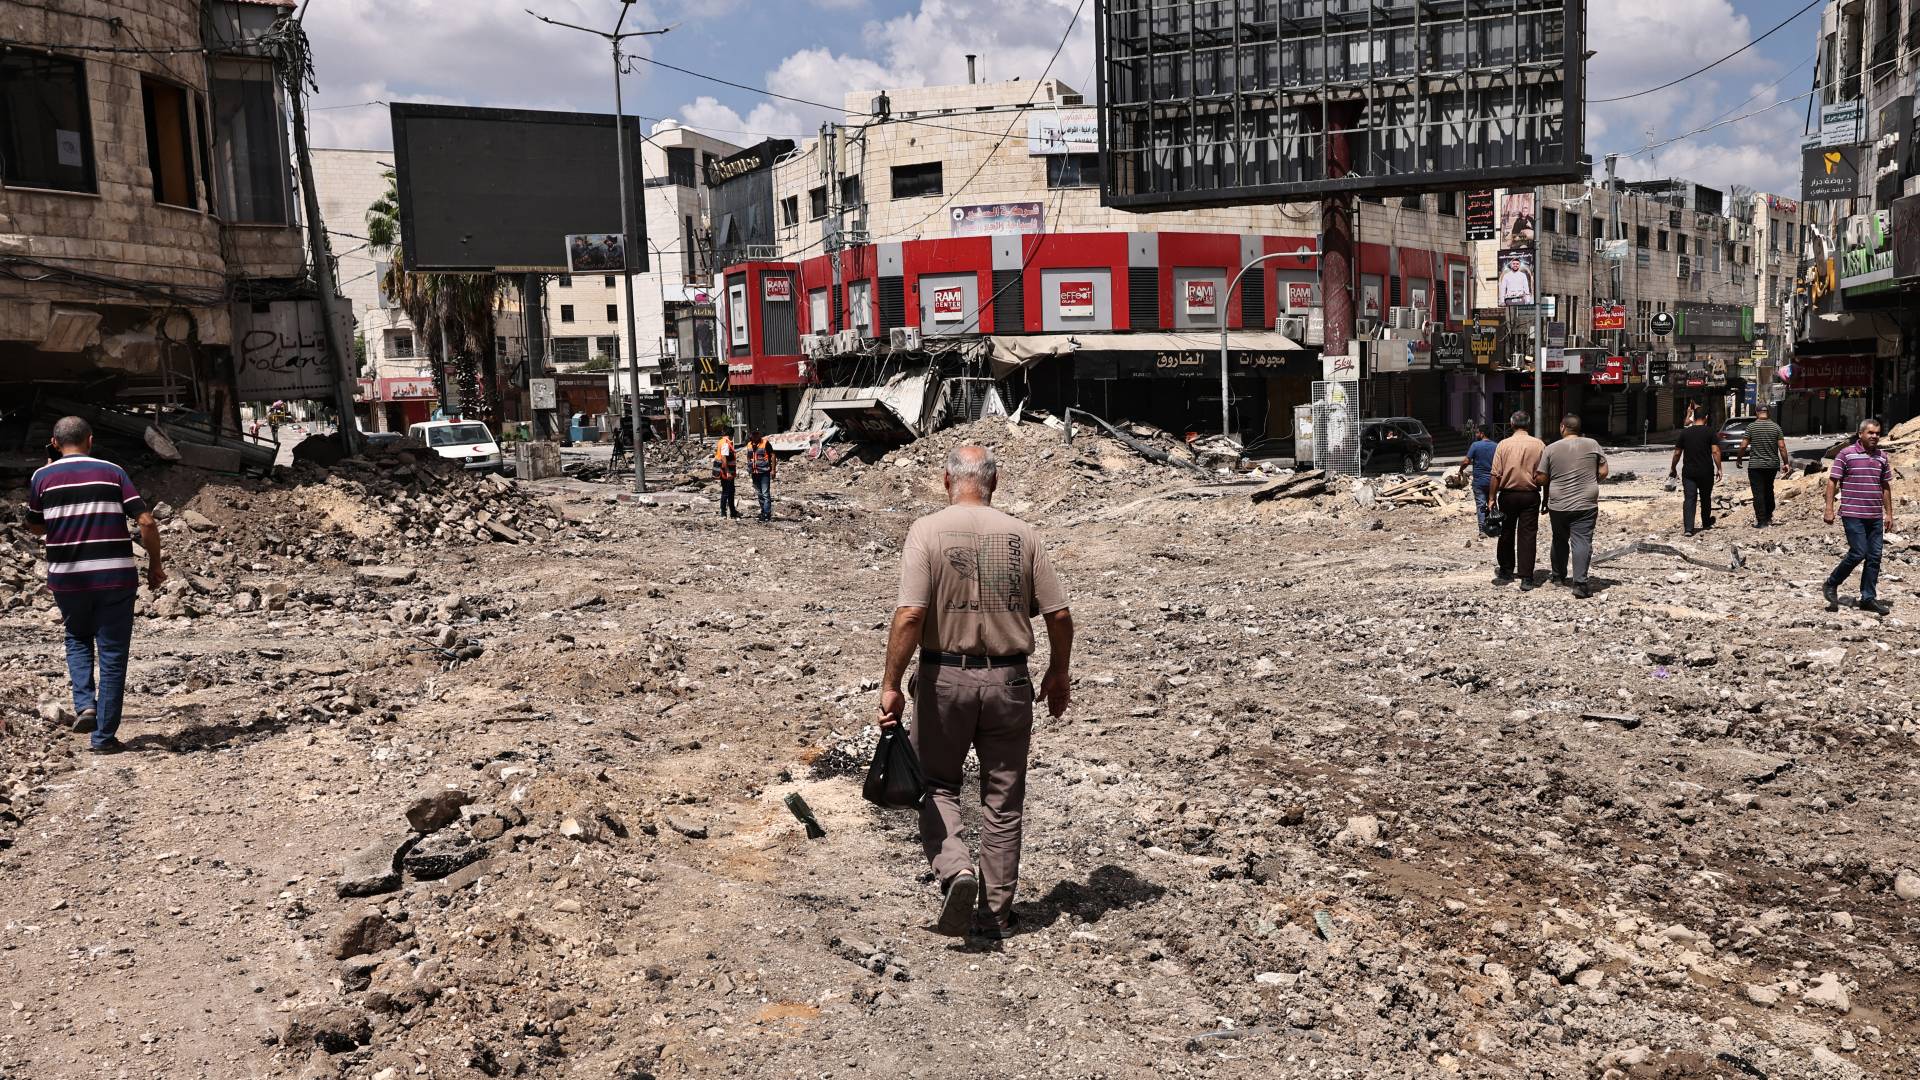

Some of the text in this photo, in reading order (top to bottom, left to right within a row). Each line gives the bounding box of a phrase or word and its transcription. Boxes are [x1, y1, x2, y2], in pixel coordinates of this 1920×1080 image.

[935, 291, 961, 302] RAMI
[1290, 287, 1312, 298] RAMI
[1156, 352, 1286, 369] مجوهرات الفاروق
